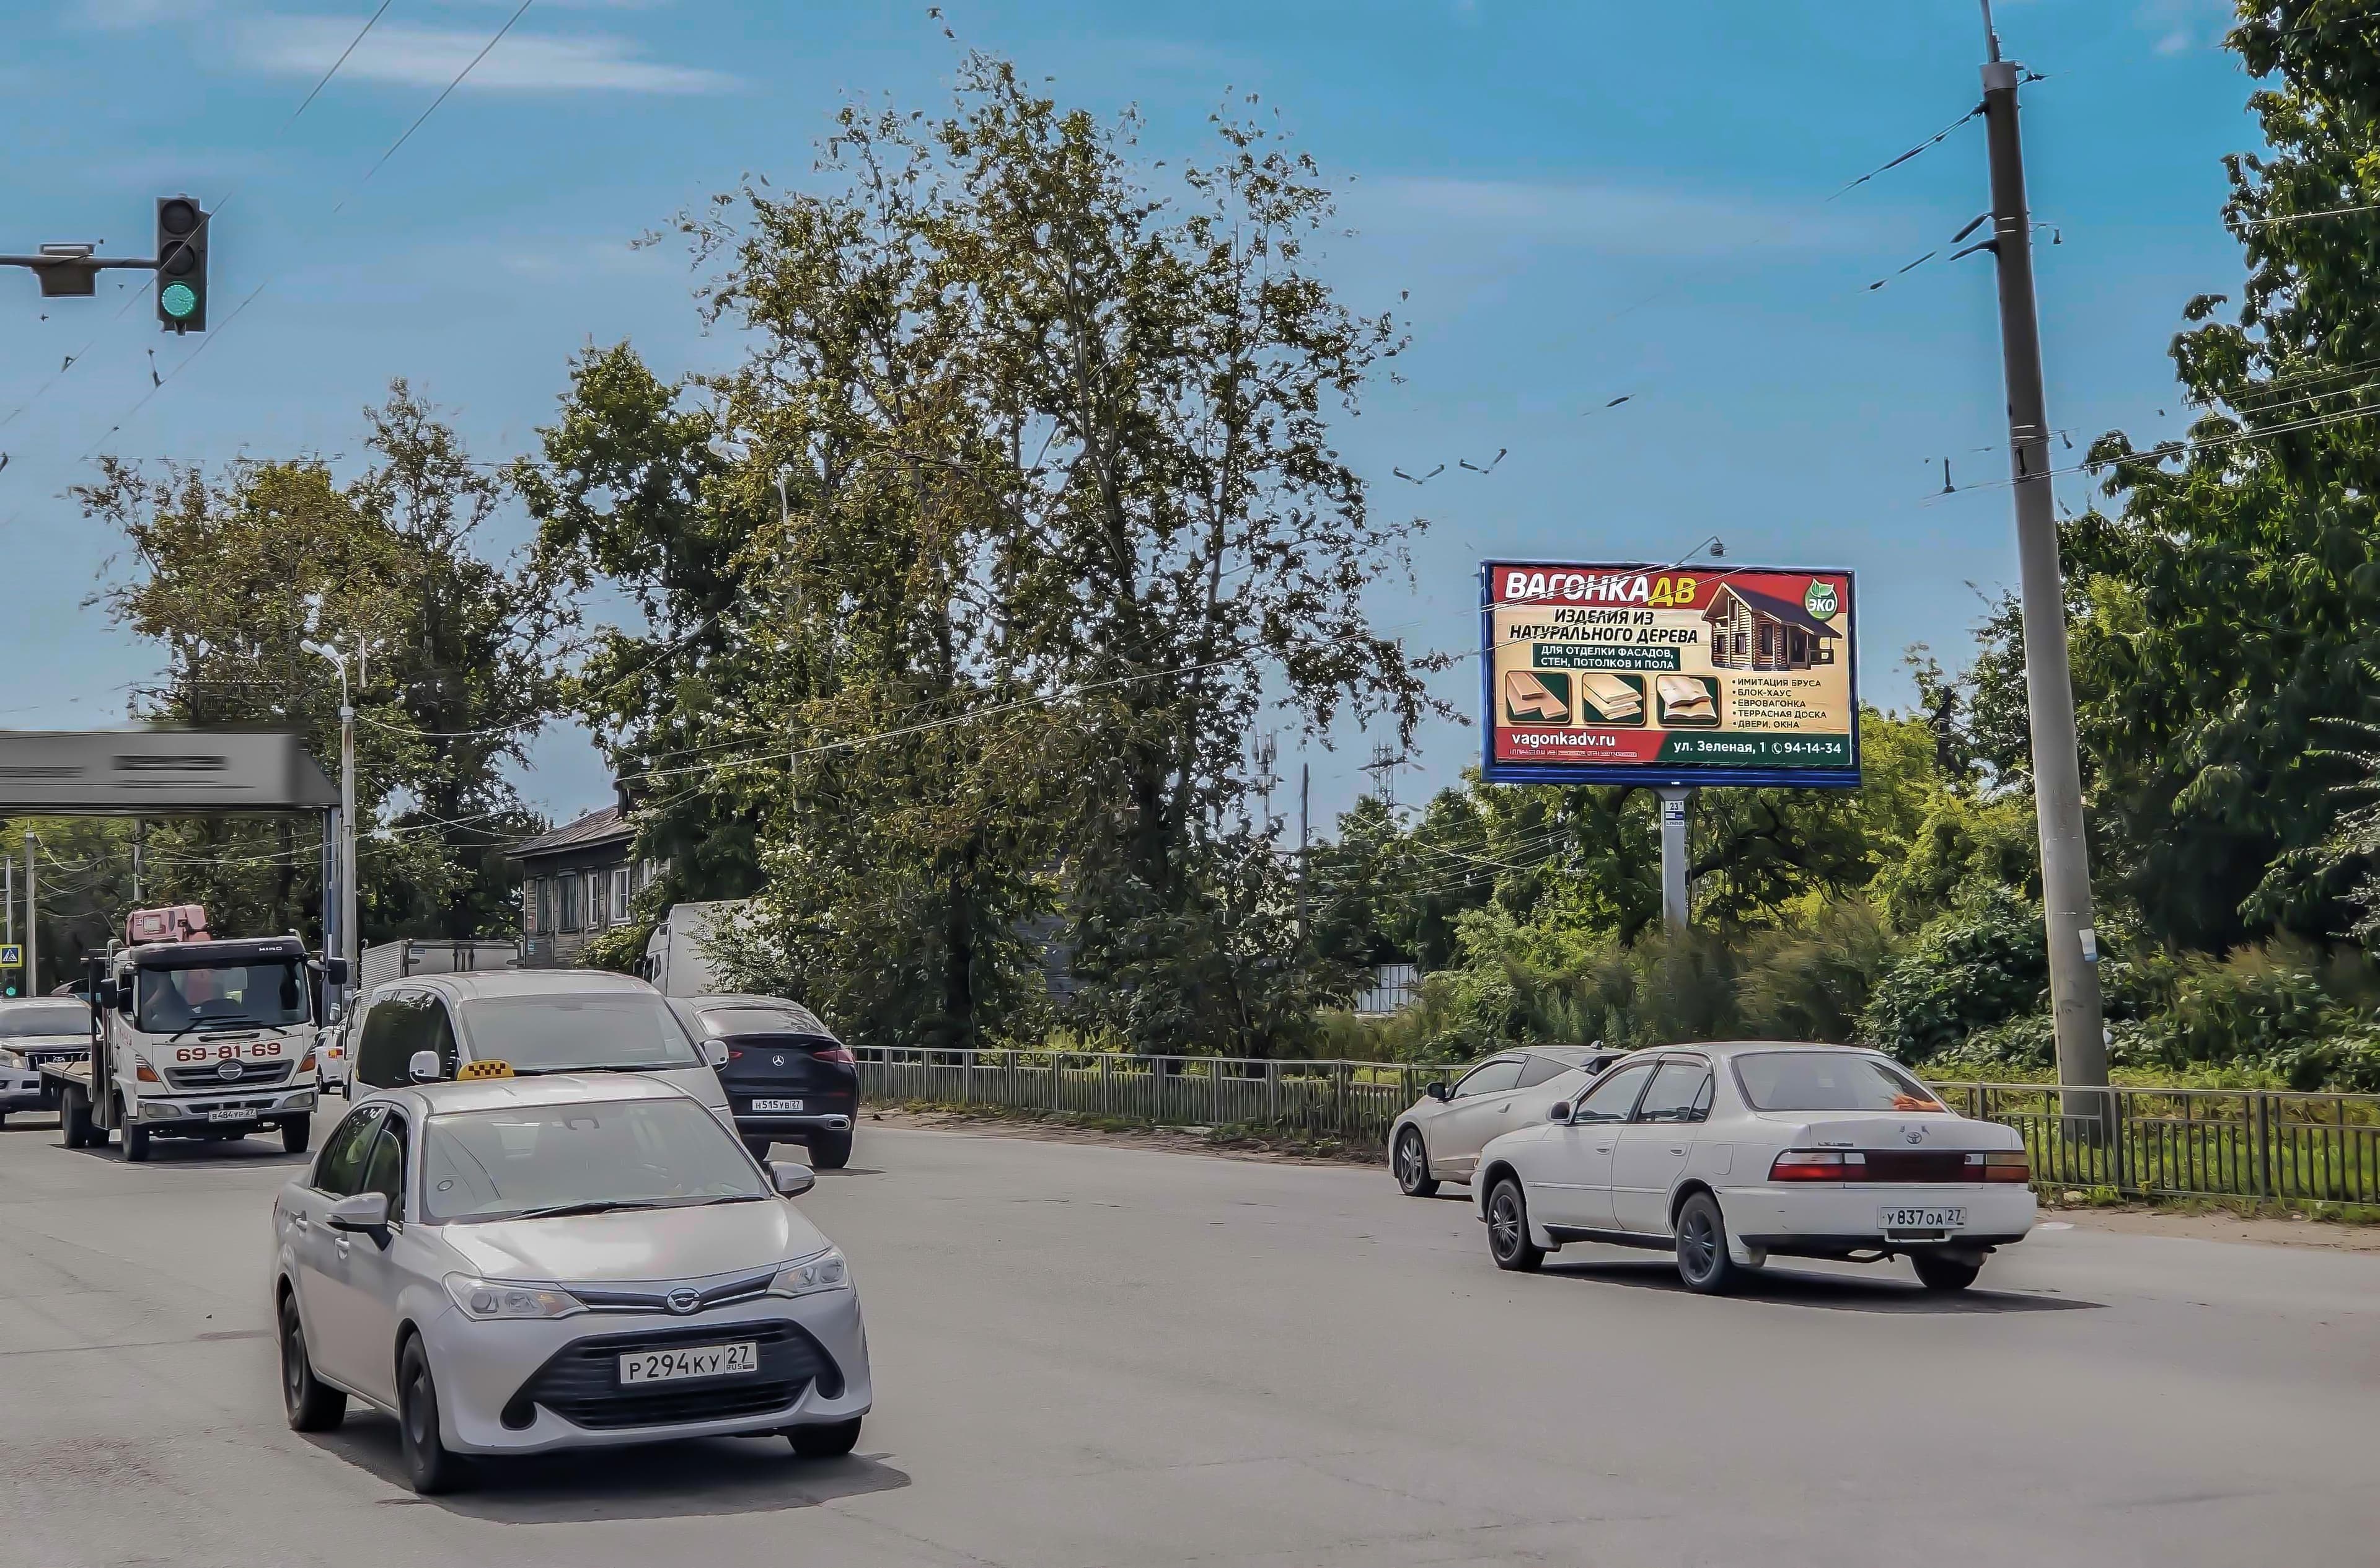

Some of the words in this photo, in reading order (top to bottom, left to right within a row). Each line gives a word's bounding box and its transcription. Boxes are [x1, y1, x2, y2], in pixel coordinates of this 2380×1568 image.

[1808, 599, 1835, 612] ЭКО
[1554, 609, 1629, 624] ИЗДЕЛИЯ
[1634, 611, 1654, 625] ИЗ
[1510, 625, 1633, 642] НАТУРАЛЬНОГО
[1636, 628, 1698, 644] ДЕРЕВА
[1541, 646, 1562, 656] ДЛЯ
[1566, 646, 1615, 657] ОТДЕЛКИ
[1618, 648, 1673, 659] ФАСАДОВ,
[1541, 657, 1571, 667] СТЕН,
[1574, 659, 1631, 668] ПОТОЛКОВ
[1644, 661, 1674, 669] ПОЛА
[1737, 678, 1788, 687] ИМИТАЦИЯ
[1737, 689, 1792, 697] БЛОК-ХАУС
[1738, 699, 1806, 708] ЕВРОВАГОНКА
[1739, 710, 1792, 718] ТЕРРАСНАЯ
[1794, 711, 1827, 719] ДОСКА
[1738, 720, 1771, 729] ДВЕРИ,
[1512, 731, 1615, 748] vagonkadv.ru
[1673, 742, 1693, 753] ул.
[1697, 740, 1756, 754] Зеленая,
[1760, 742, 1766, 752] 1
[1784, 742, 1841, 754] 94-14-34
[176, 1042, 281, 1062] 69-81-69
[1948, 1209, 1961, 1222] 27
[727, 1346, 749, 1364] 27
